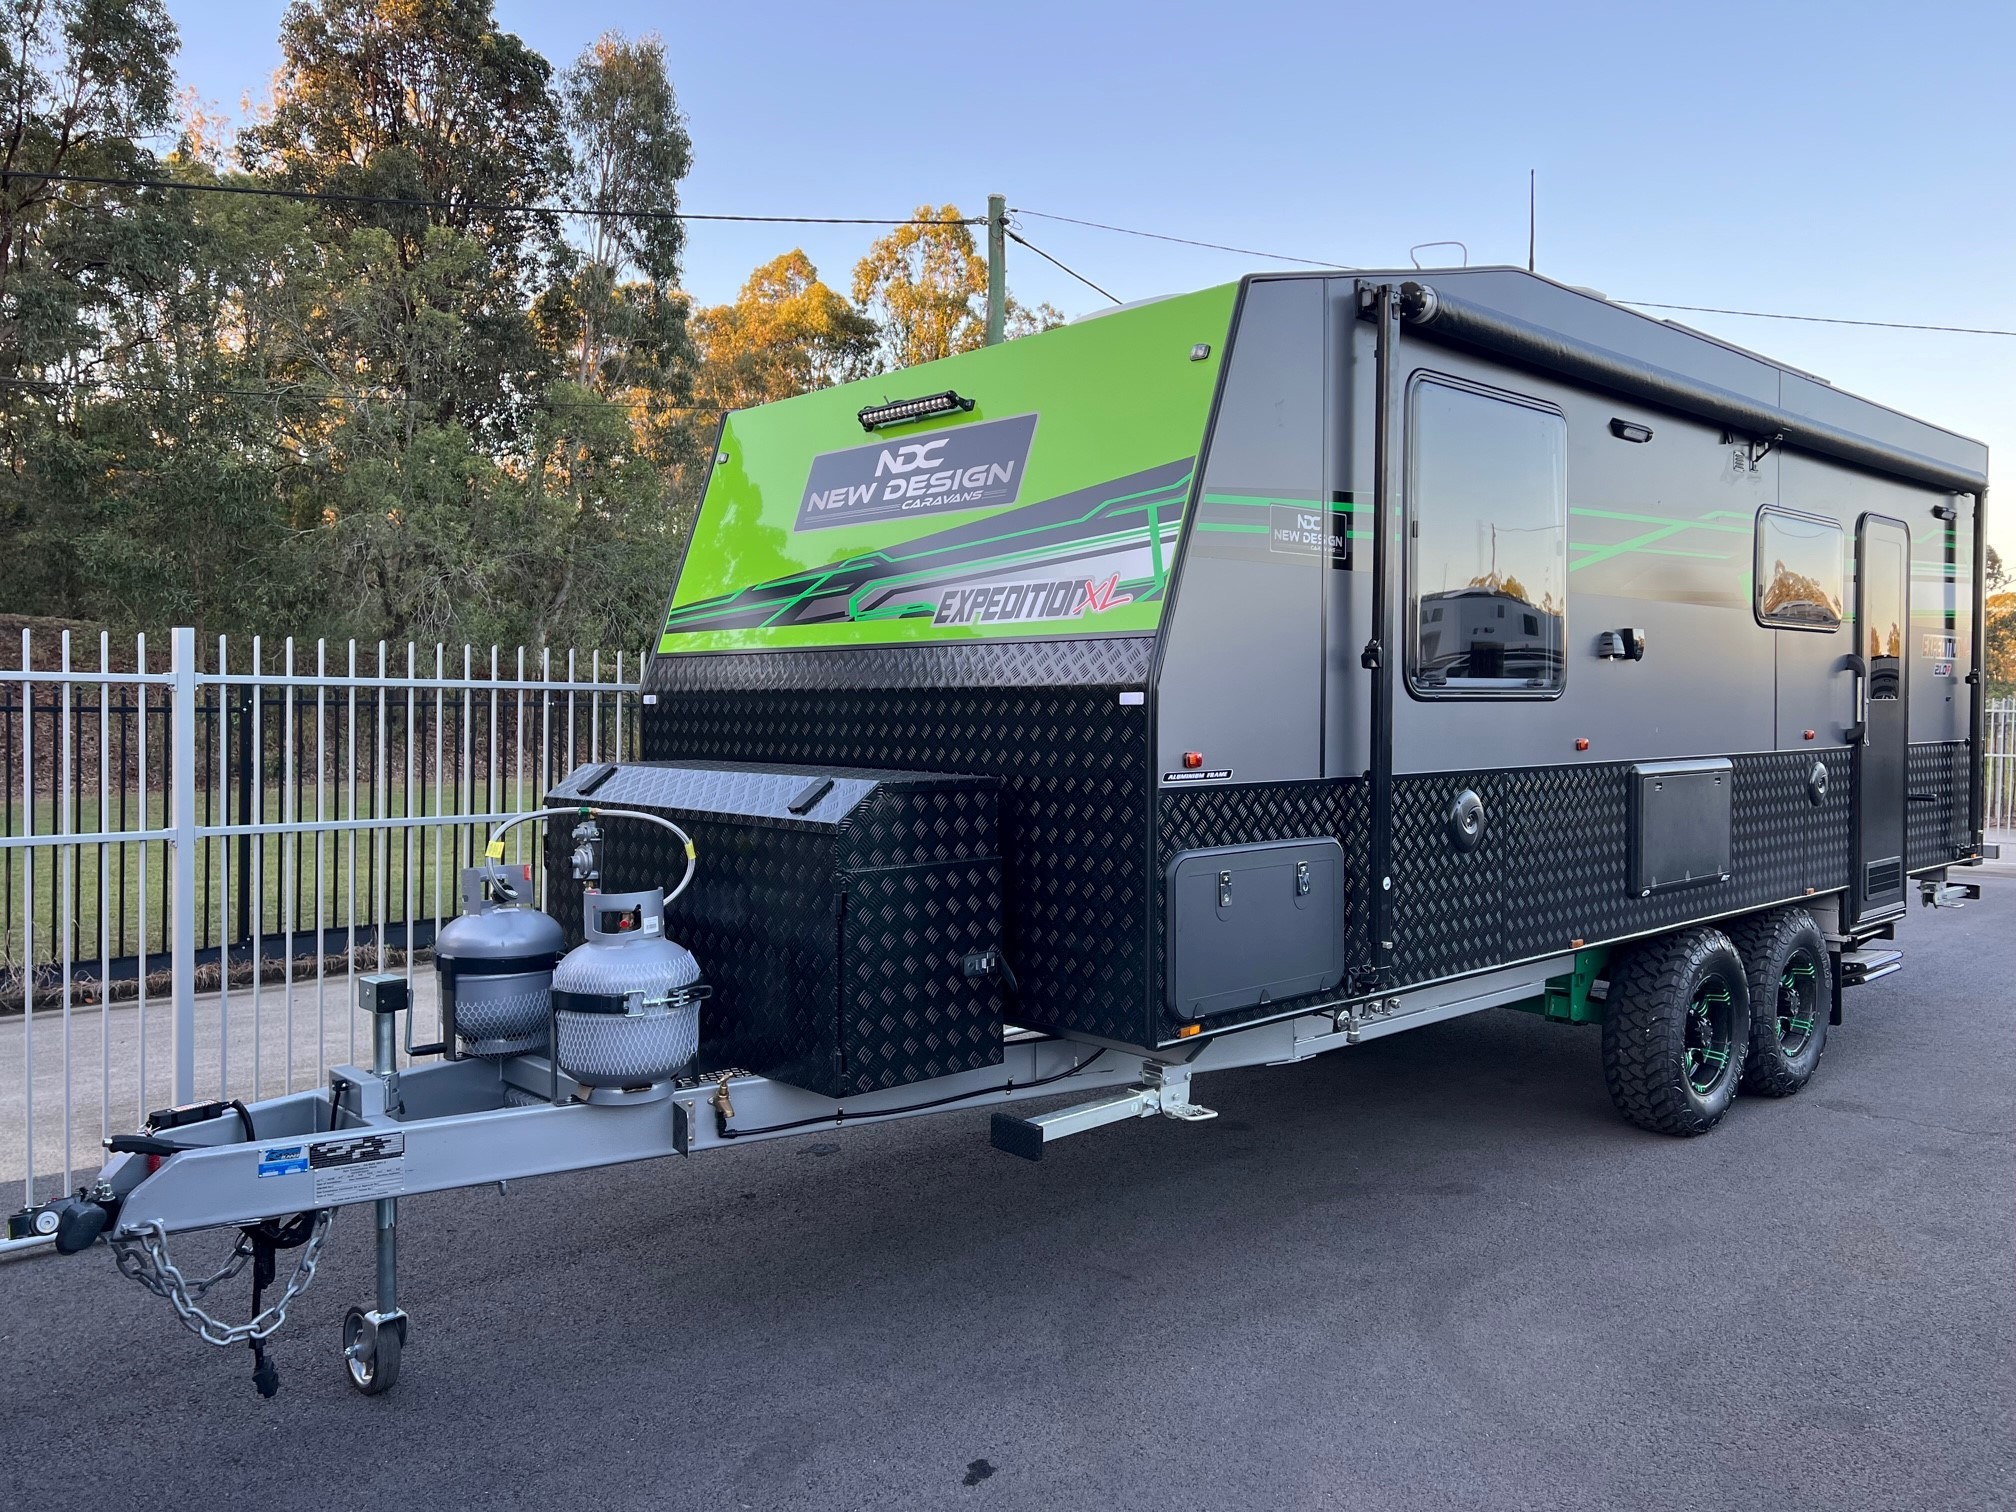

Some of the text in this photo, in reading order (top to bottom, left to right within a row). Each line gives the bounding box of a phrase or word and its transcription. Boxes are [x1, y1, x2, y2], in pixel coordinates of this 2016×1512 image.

[875, 438, 950, 477] NDC
[806, 460, 1015, 512] NEW DESIGN
[901, 489, 985, 511] CARAVANS
[1297, 513, 1322, 531] NDC
[1274, 528, 1343, 548] NEW DESIGN
[933, 573, 1132, 625] EXPEDITION XL
[1167, 772, 1206, 780] ALUMINIUM
